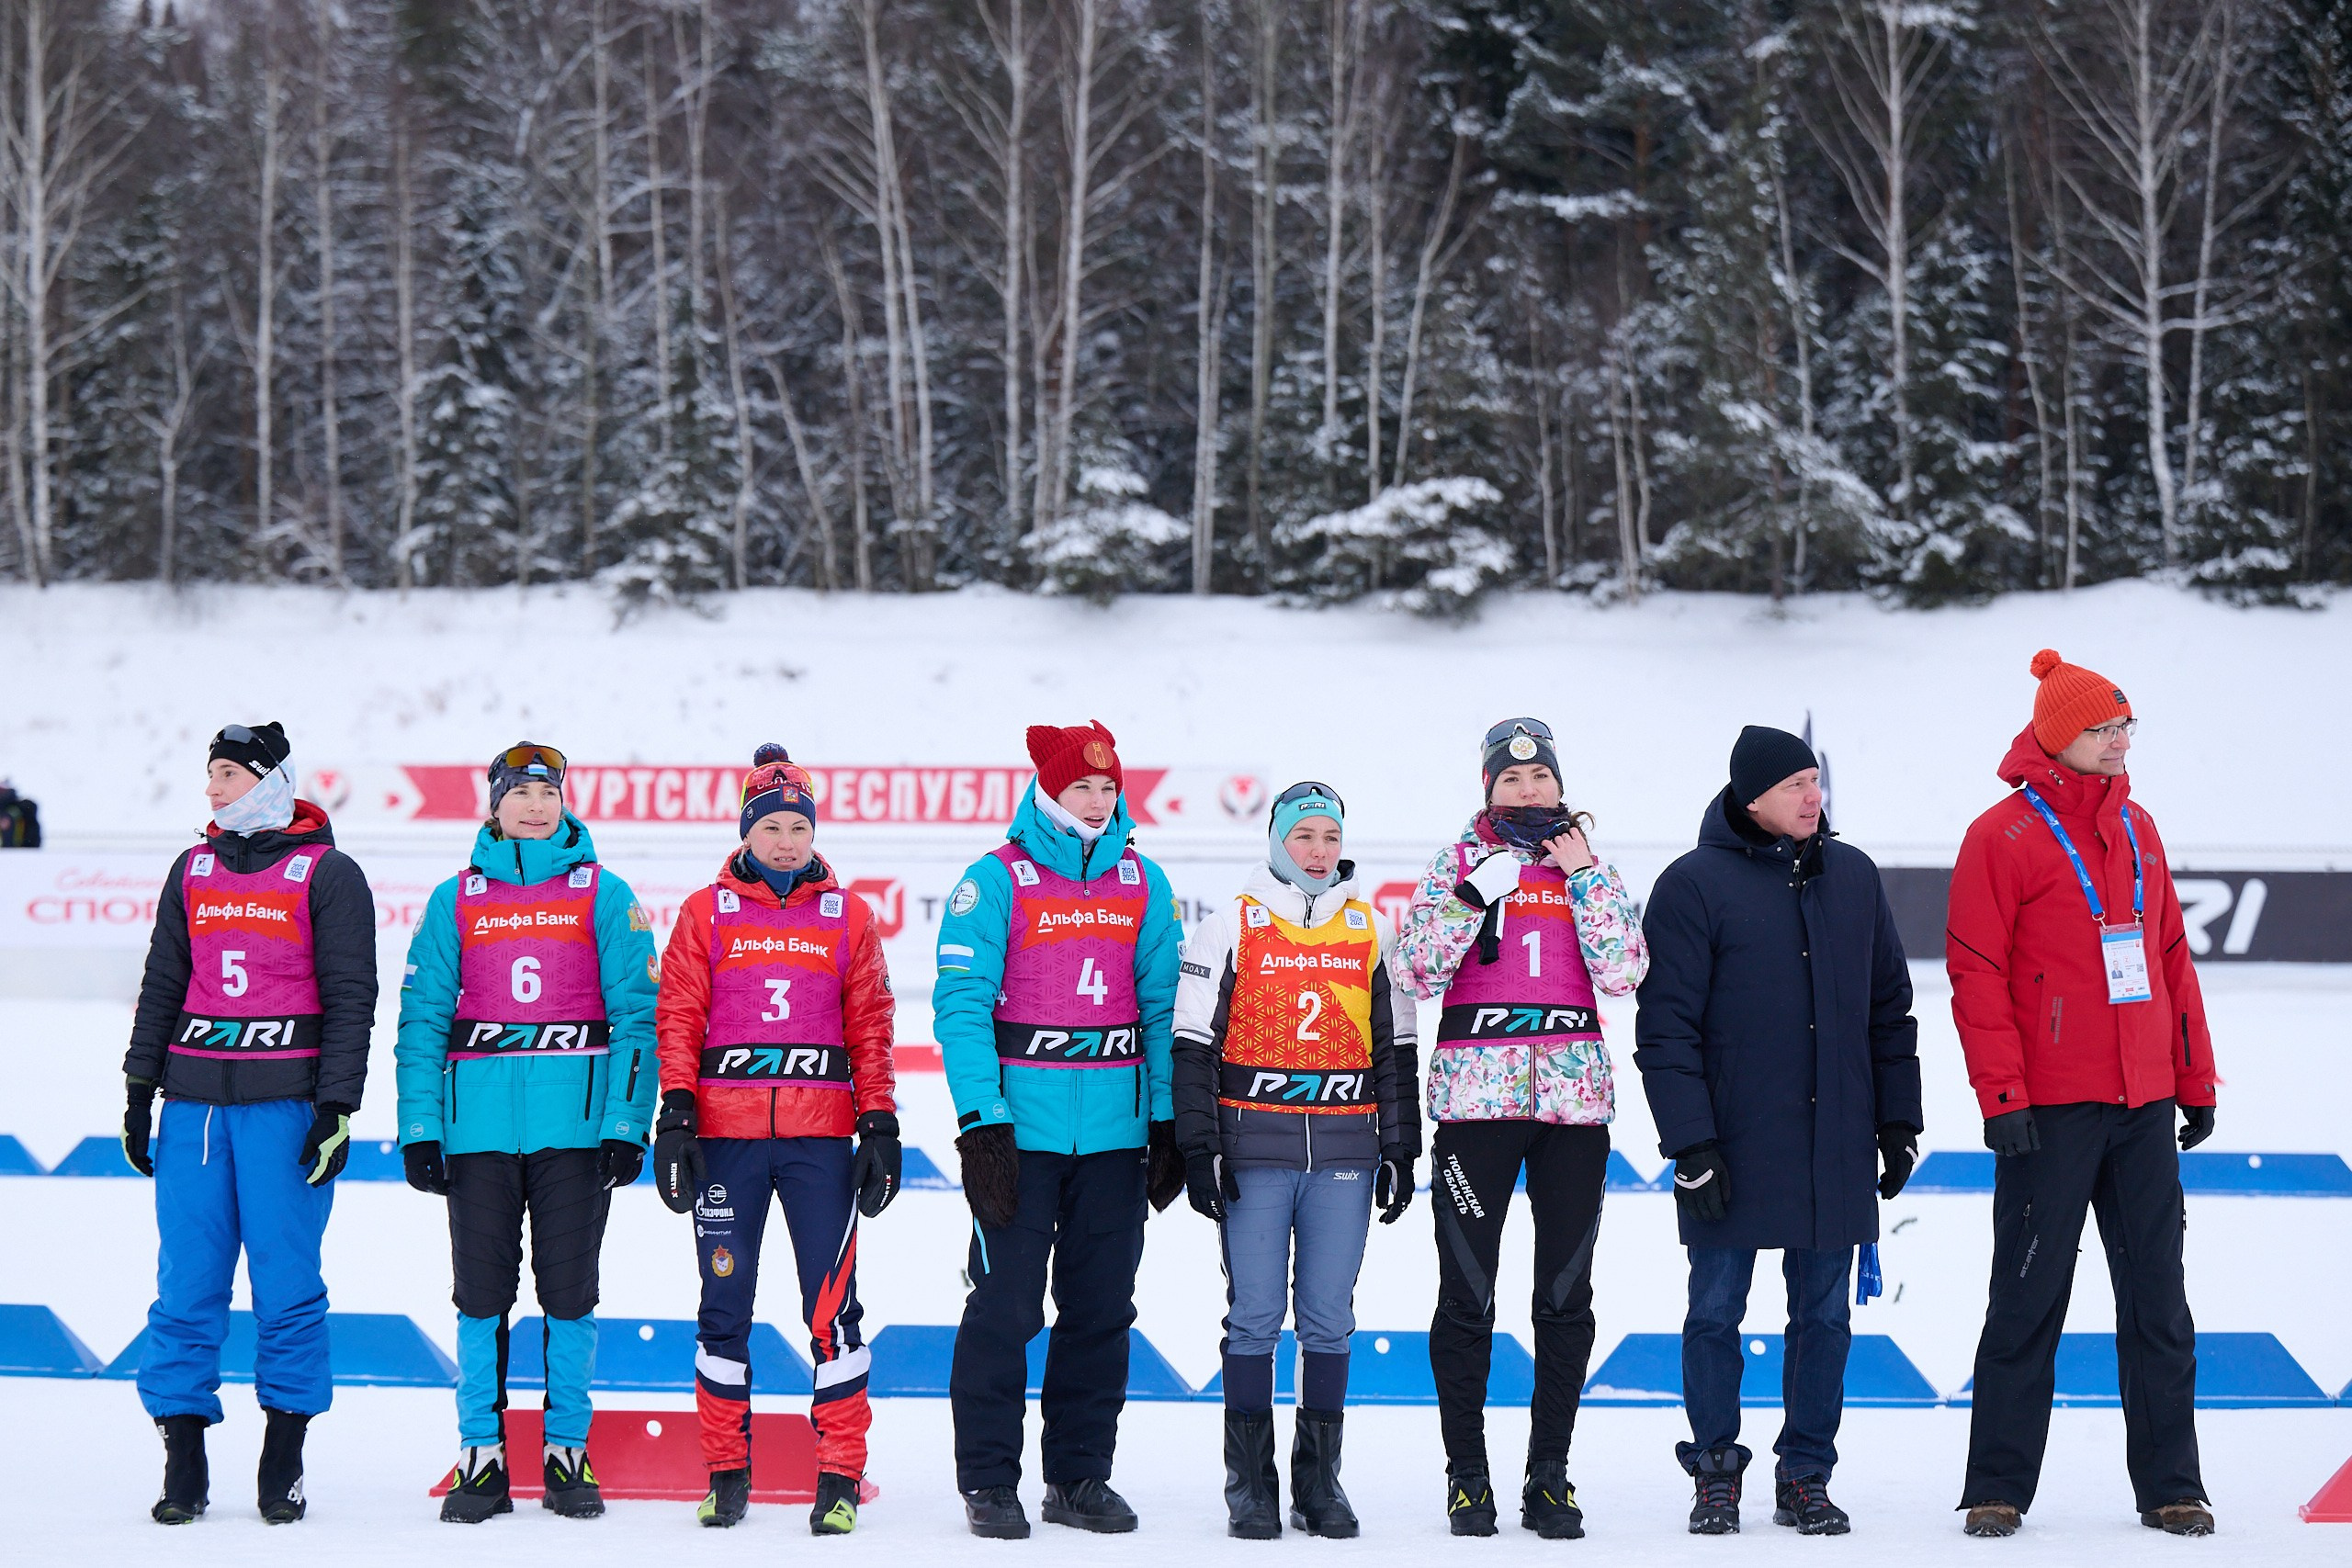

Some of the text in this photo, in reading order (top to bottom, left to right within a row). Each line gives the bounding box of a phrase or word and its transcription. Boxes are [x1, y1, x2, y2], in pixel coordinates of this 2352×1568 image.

[248, 760, 271, 776] swi
[469, 768, 741, 820] УУРТСКА
[1300, 802, 1326, 810] PARI
[1122, 874, 1136, 882] 2025
[823, 907, 838, 915] 2025
[1504, 889, 1539, 907] ьфа
[196, 902, 288, 923] Альфа Банк
[474, 911, 579, 933] Альфа Банк
[1038, 908, 1134, 931] Альфа Банк
[2172, 877, 2267, 955] RI
[729, 936, 829, 958] Альфа Банк
[1521, 931, 1541, 977] 1
[221, 950, 248, 998] 5
[1183, 964, 1205, 976] MOAX
[1261, 953, 1362, 973] Альфа Банк
[511, 956, 542, 1003] 6
[1076, 957, 1108, 1005] 4
[761, 978, 791, 1021] 3
[1296, 991, 1322, 1041] 2
[1470, 1008, 1588, 1034] PARI
[180, 1018, 295, 1047] PARI
[466, 1022, 589, 1049] PARI
[1025, 1027, 1136, 1057] PARI
[718, 1047, 829, 1075] PARI
[1248, 1072, 1364, 1100] PARI
[1442, 1168, 1469, 1215] ОБЛАСТЬ
[1447, 1153, 1486, 1219] ТЮМЕНСКАЯ
[2019, 1234, 2039, 1278] stayer
